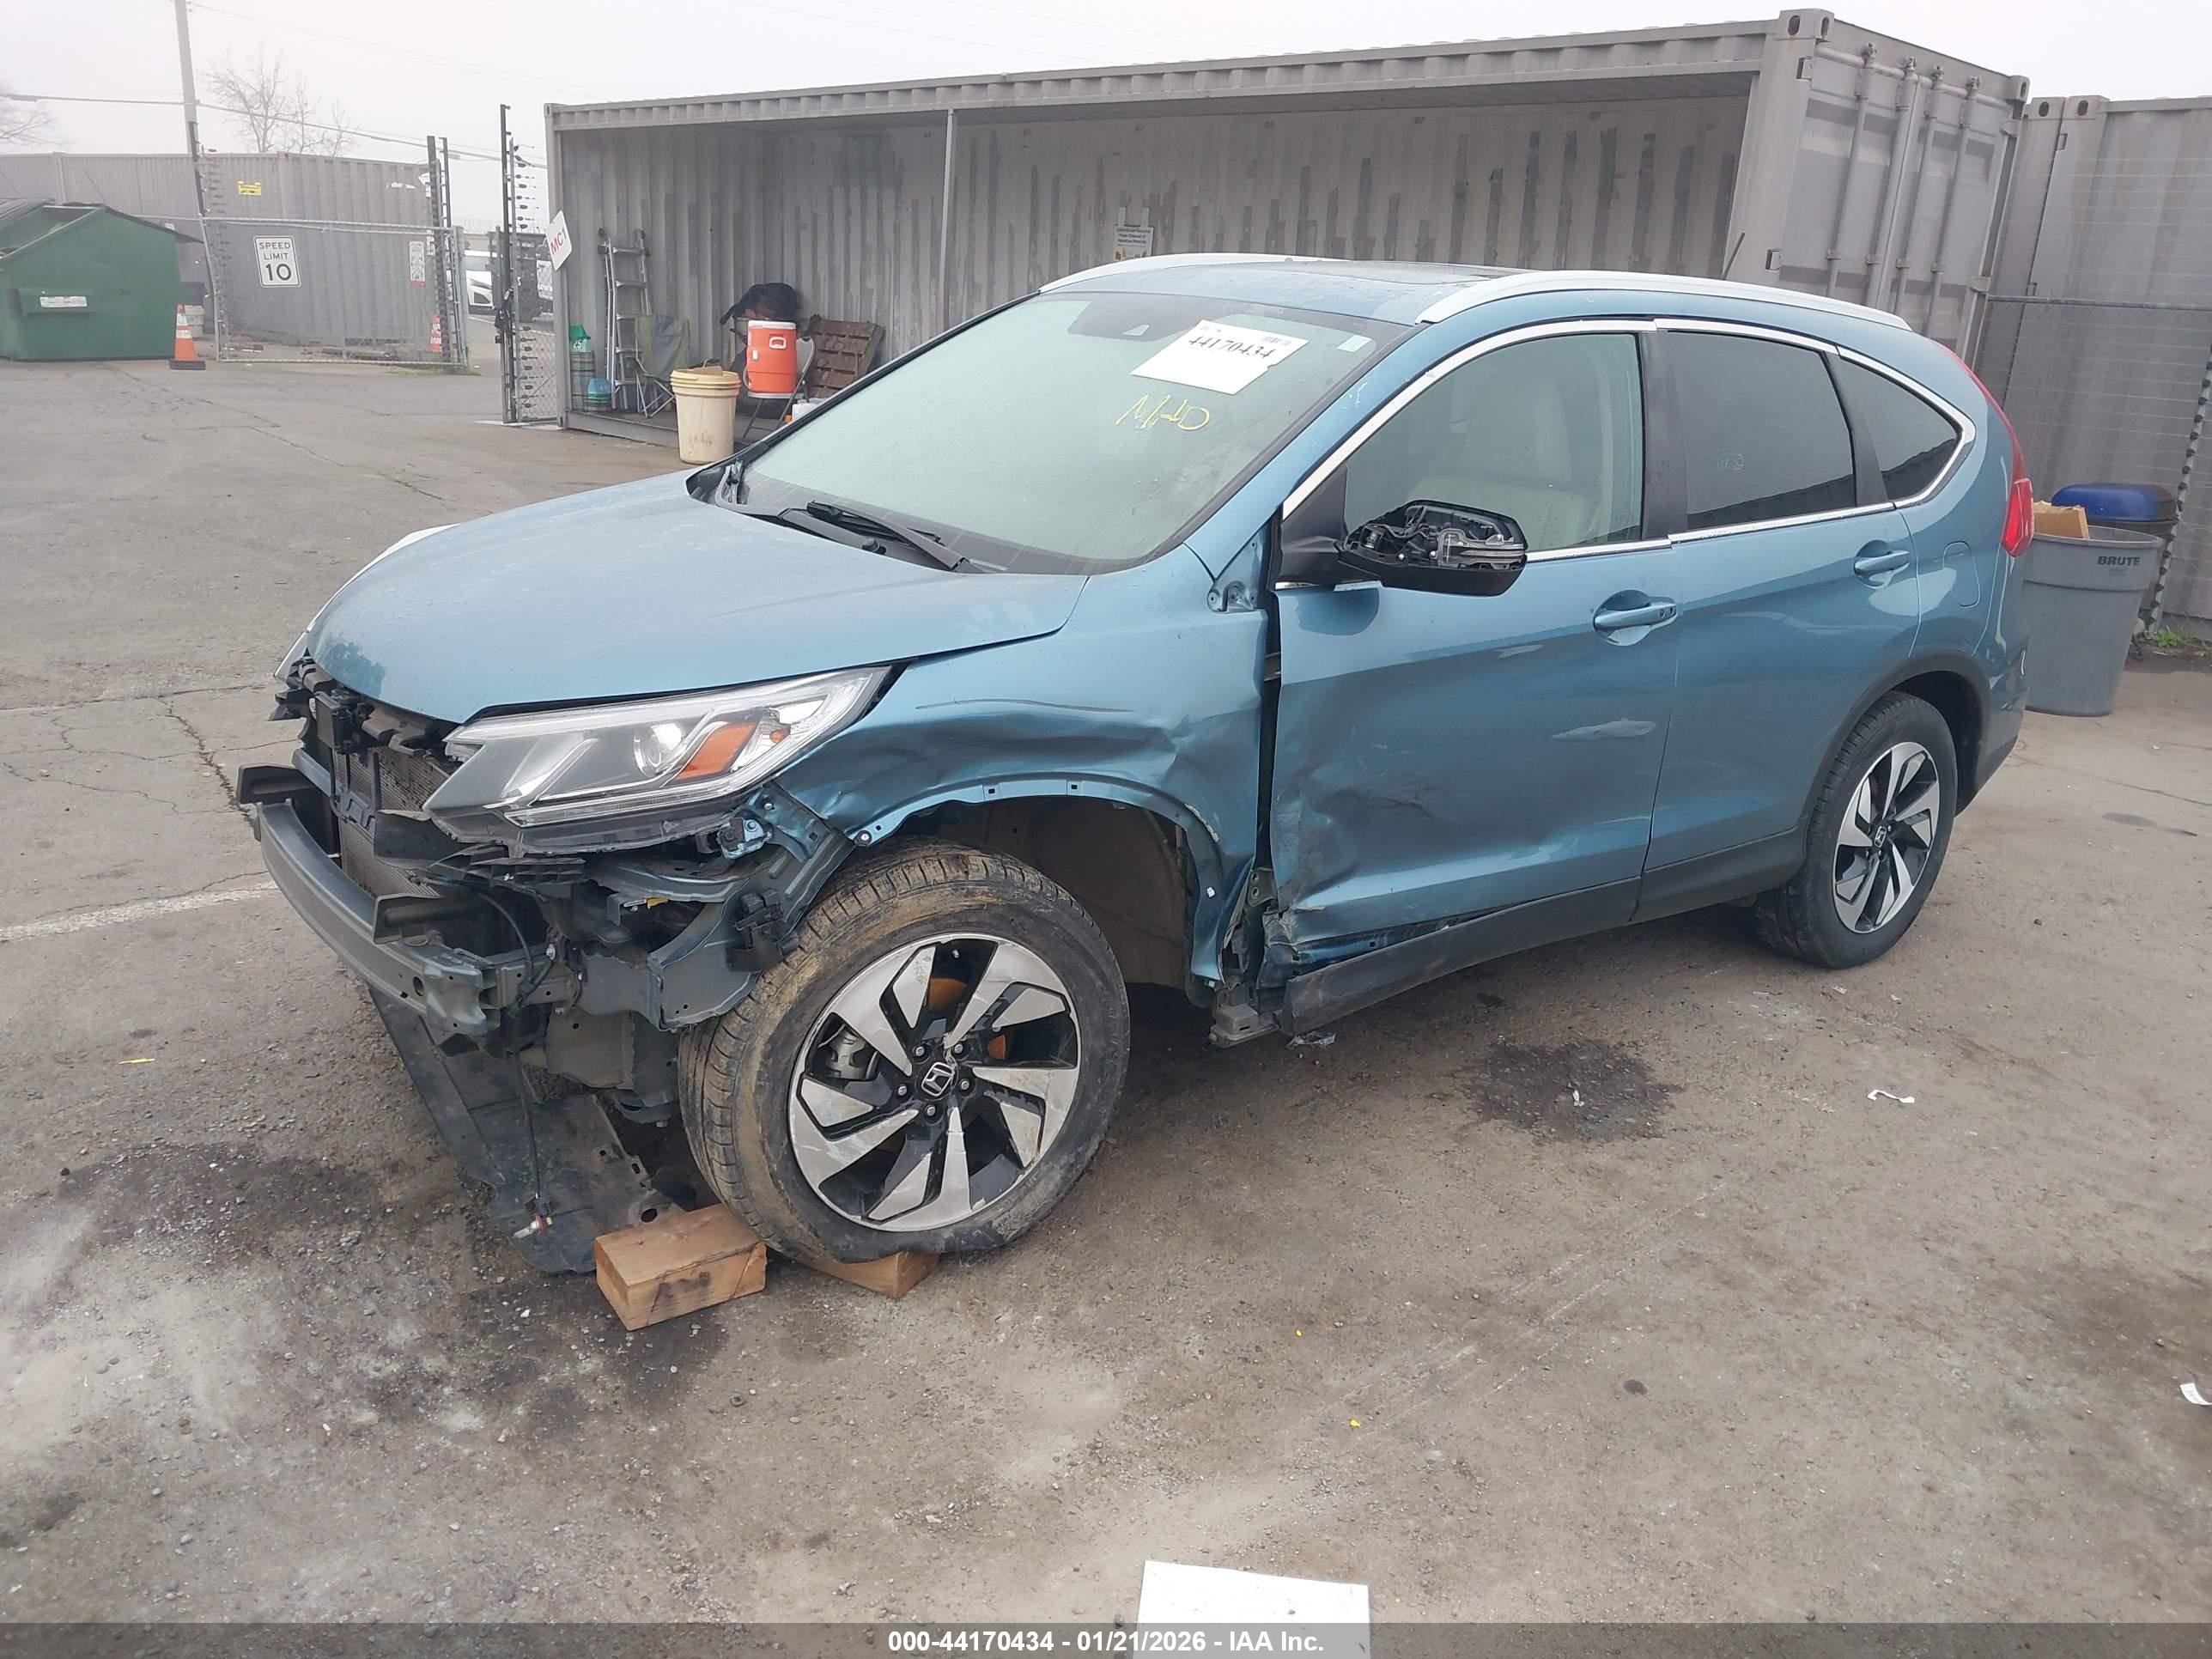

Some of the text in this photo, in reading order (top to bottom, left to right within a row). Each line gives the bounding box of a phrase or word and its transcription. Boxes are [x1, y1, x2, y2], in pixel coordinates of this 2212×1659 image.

[550, 228, 567, 255] MC1
[265, 264, 291, 281] 10
[1188, 336, 1276, 358] 44170434
[2097, 556, 2141, 566] BRUTE
